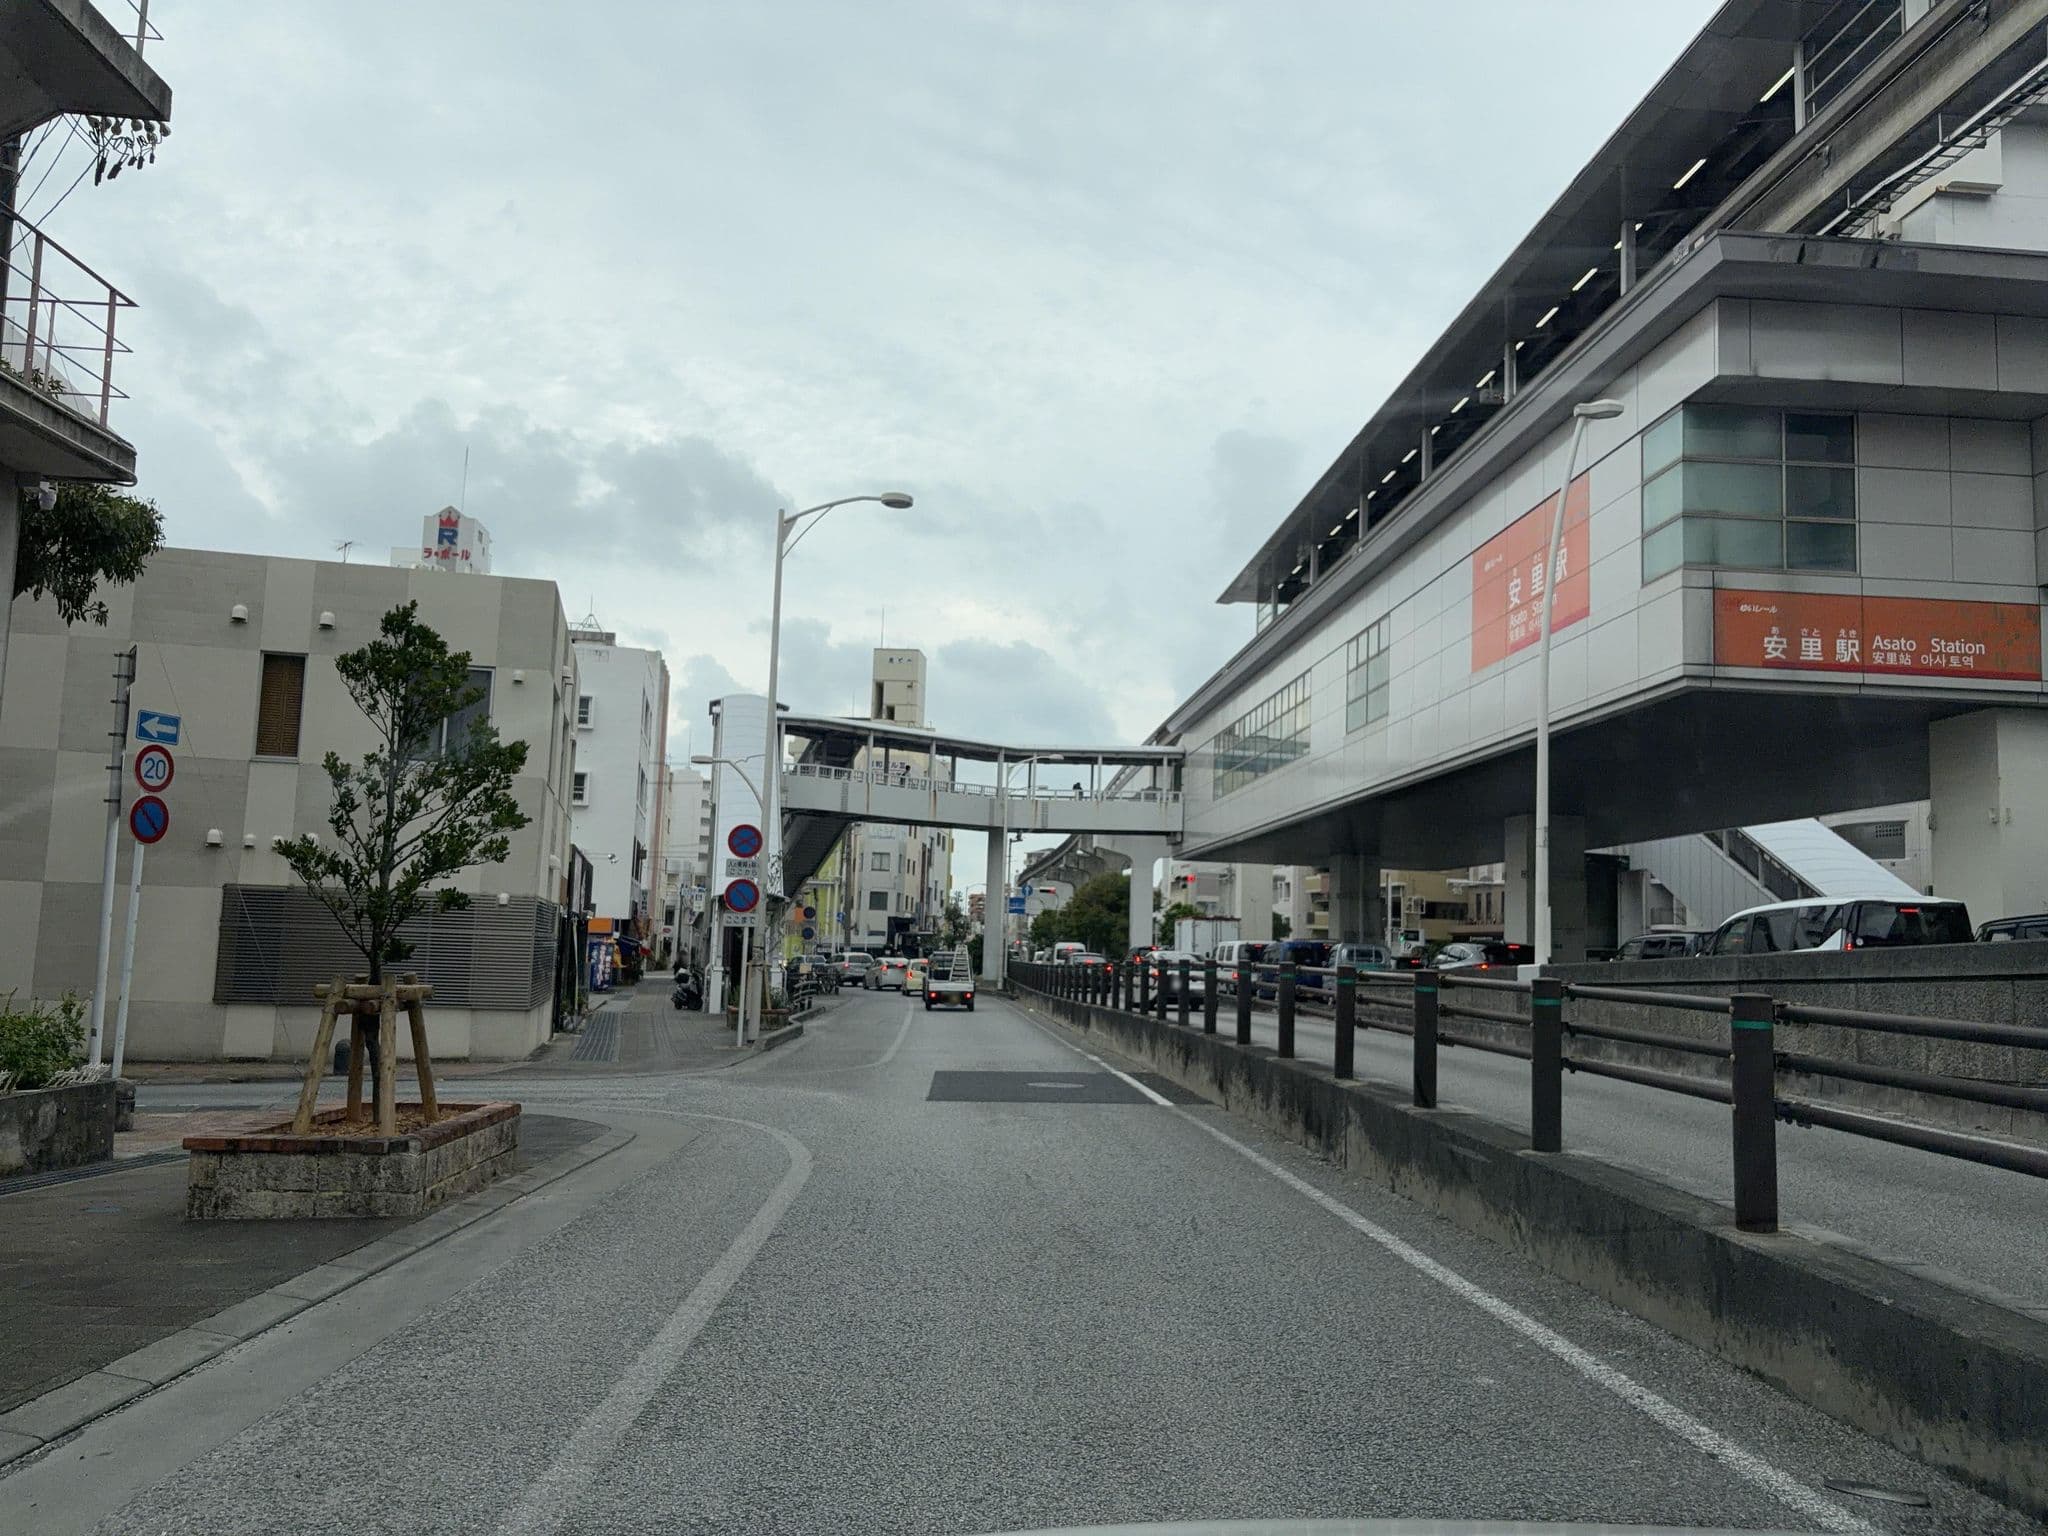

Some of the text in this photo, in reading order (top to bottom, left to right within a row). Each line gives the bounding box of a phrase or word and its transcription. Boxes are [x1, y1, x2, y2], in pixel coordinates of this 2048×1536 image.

[438, 527, 459, 545] R
[1763, 635, 1860, 663] 安里駅
[1872, 635, 1986, 655] Asato Station
[143, 757, 166, 780] 20
